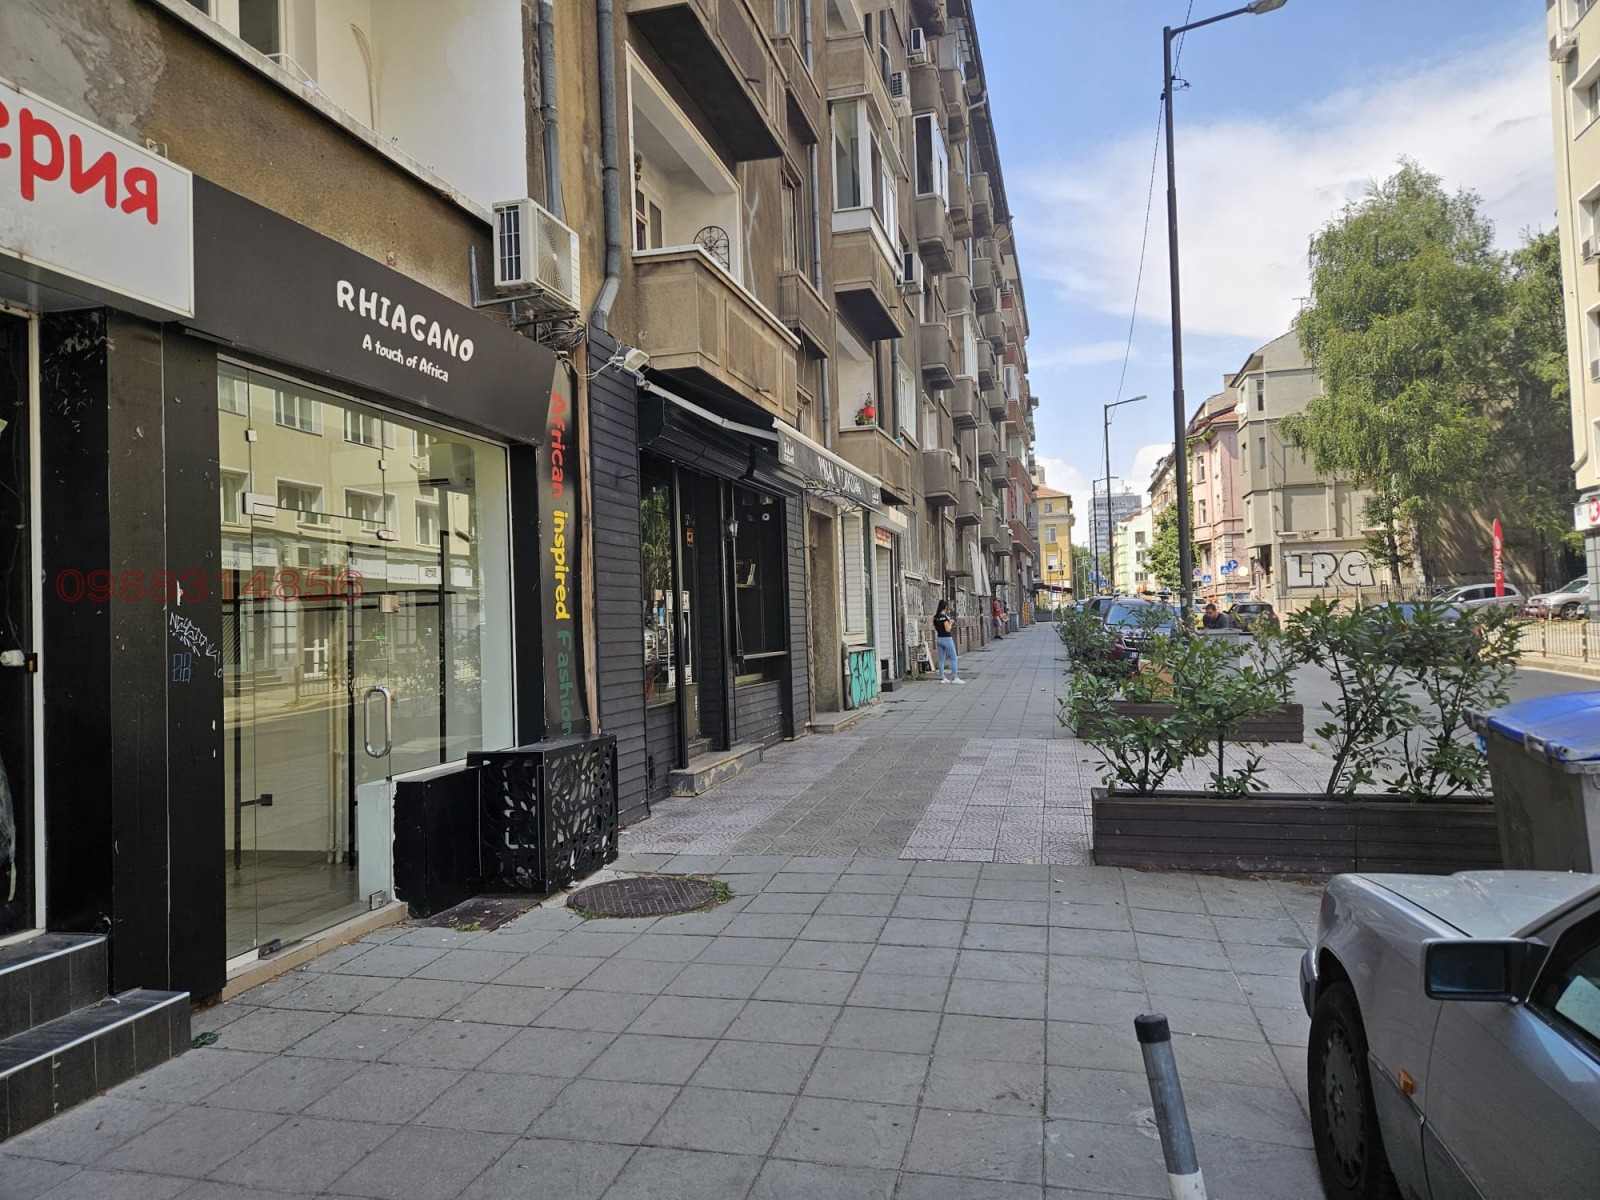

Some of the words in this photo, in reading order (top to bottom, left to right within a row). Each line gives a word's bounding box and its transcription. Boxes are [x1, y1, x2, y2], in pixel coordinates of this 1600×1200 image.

[0, 102, 158, 225] рия
[336, 280, 474, 362] RHIAGANO
[362, 333, 373, 351] A
[375, 340, 404, 365] touch
[405, 355, 419, 369] of
[419, 357, 449, 383] Africa
[551, 390, 568, 499] African
[550, 510, 571, 620] inspired
[1283, 551, 1376, 589] LPG
